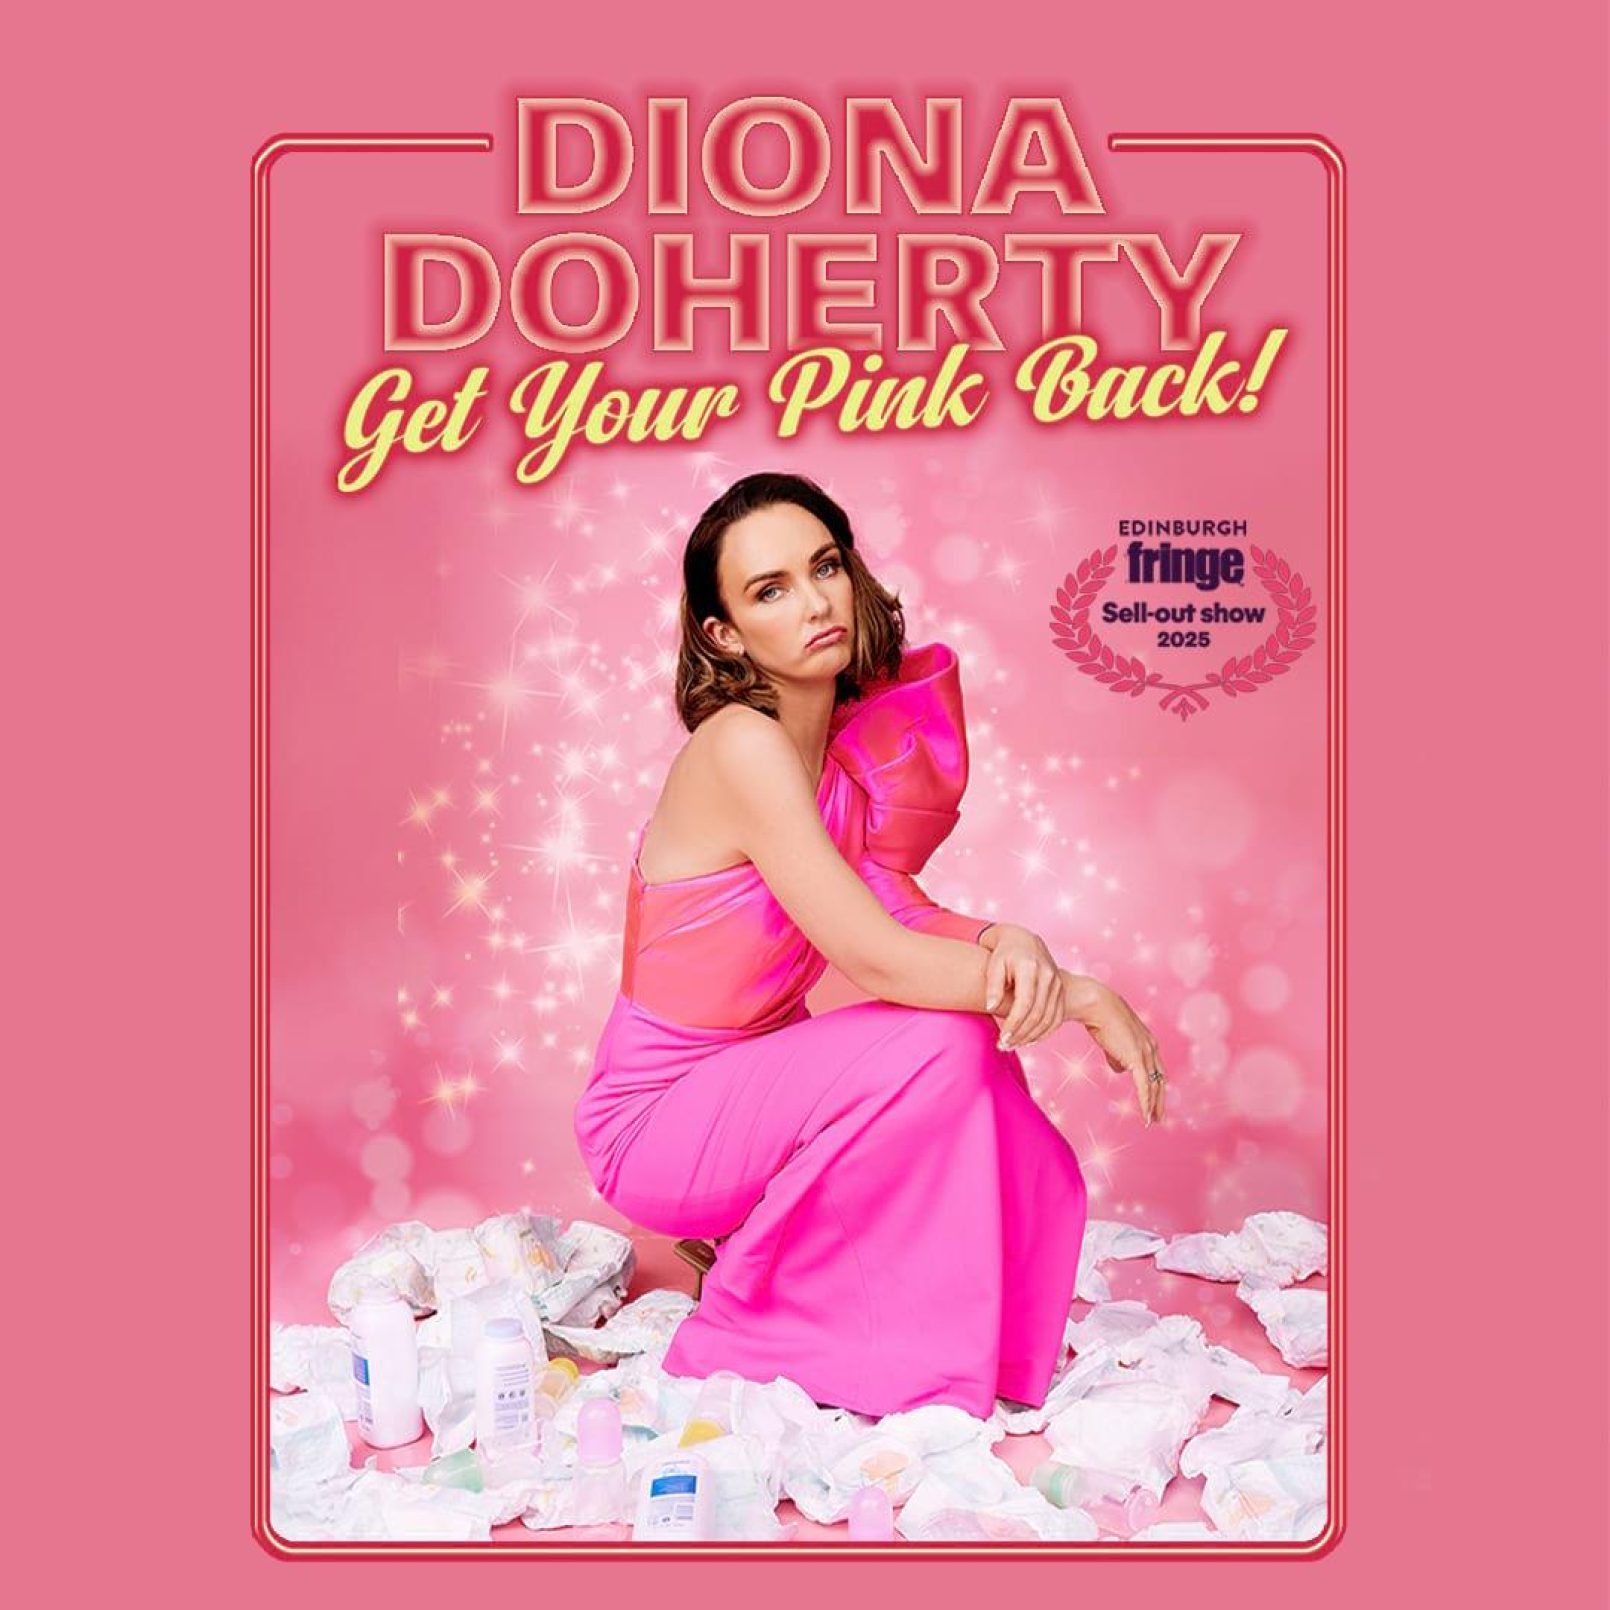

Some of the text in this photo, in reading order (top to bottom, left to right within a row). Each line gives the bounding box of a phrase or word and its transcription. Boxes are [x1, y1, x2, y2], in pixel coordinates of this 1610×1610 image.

[516, 96, 1106, 217] DIONA
[382, 232, 1242, 354] DOHERTY
[337, 329, 1289, 492] Get Your Pink Back!
[1118, 519, 1248, 537] EDINBURGH
[1126, 540, 1245, 592] fringe
[1101, 601, 1266, 624] Sell-out show
[1156, 631, 1211, 648] 2025
